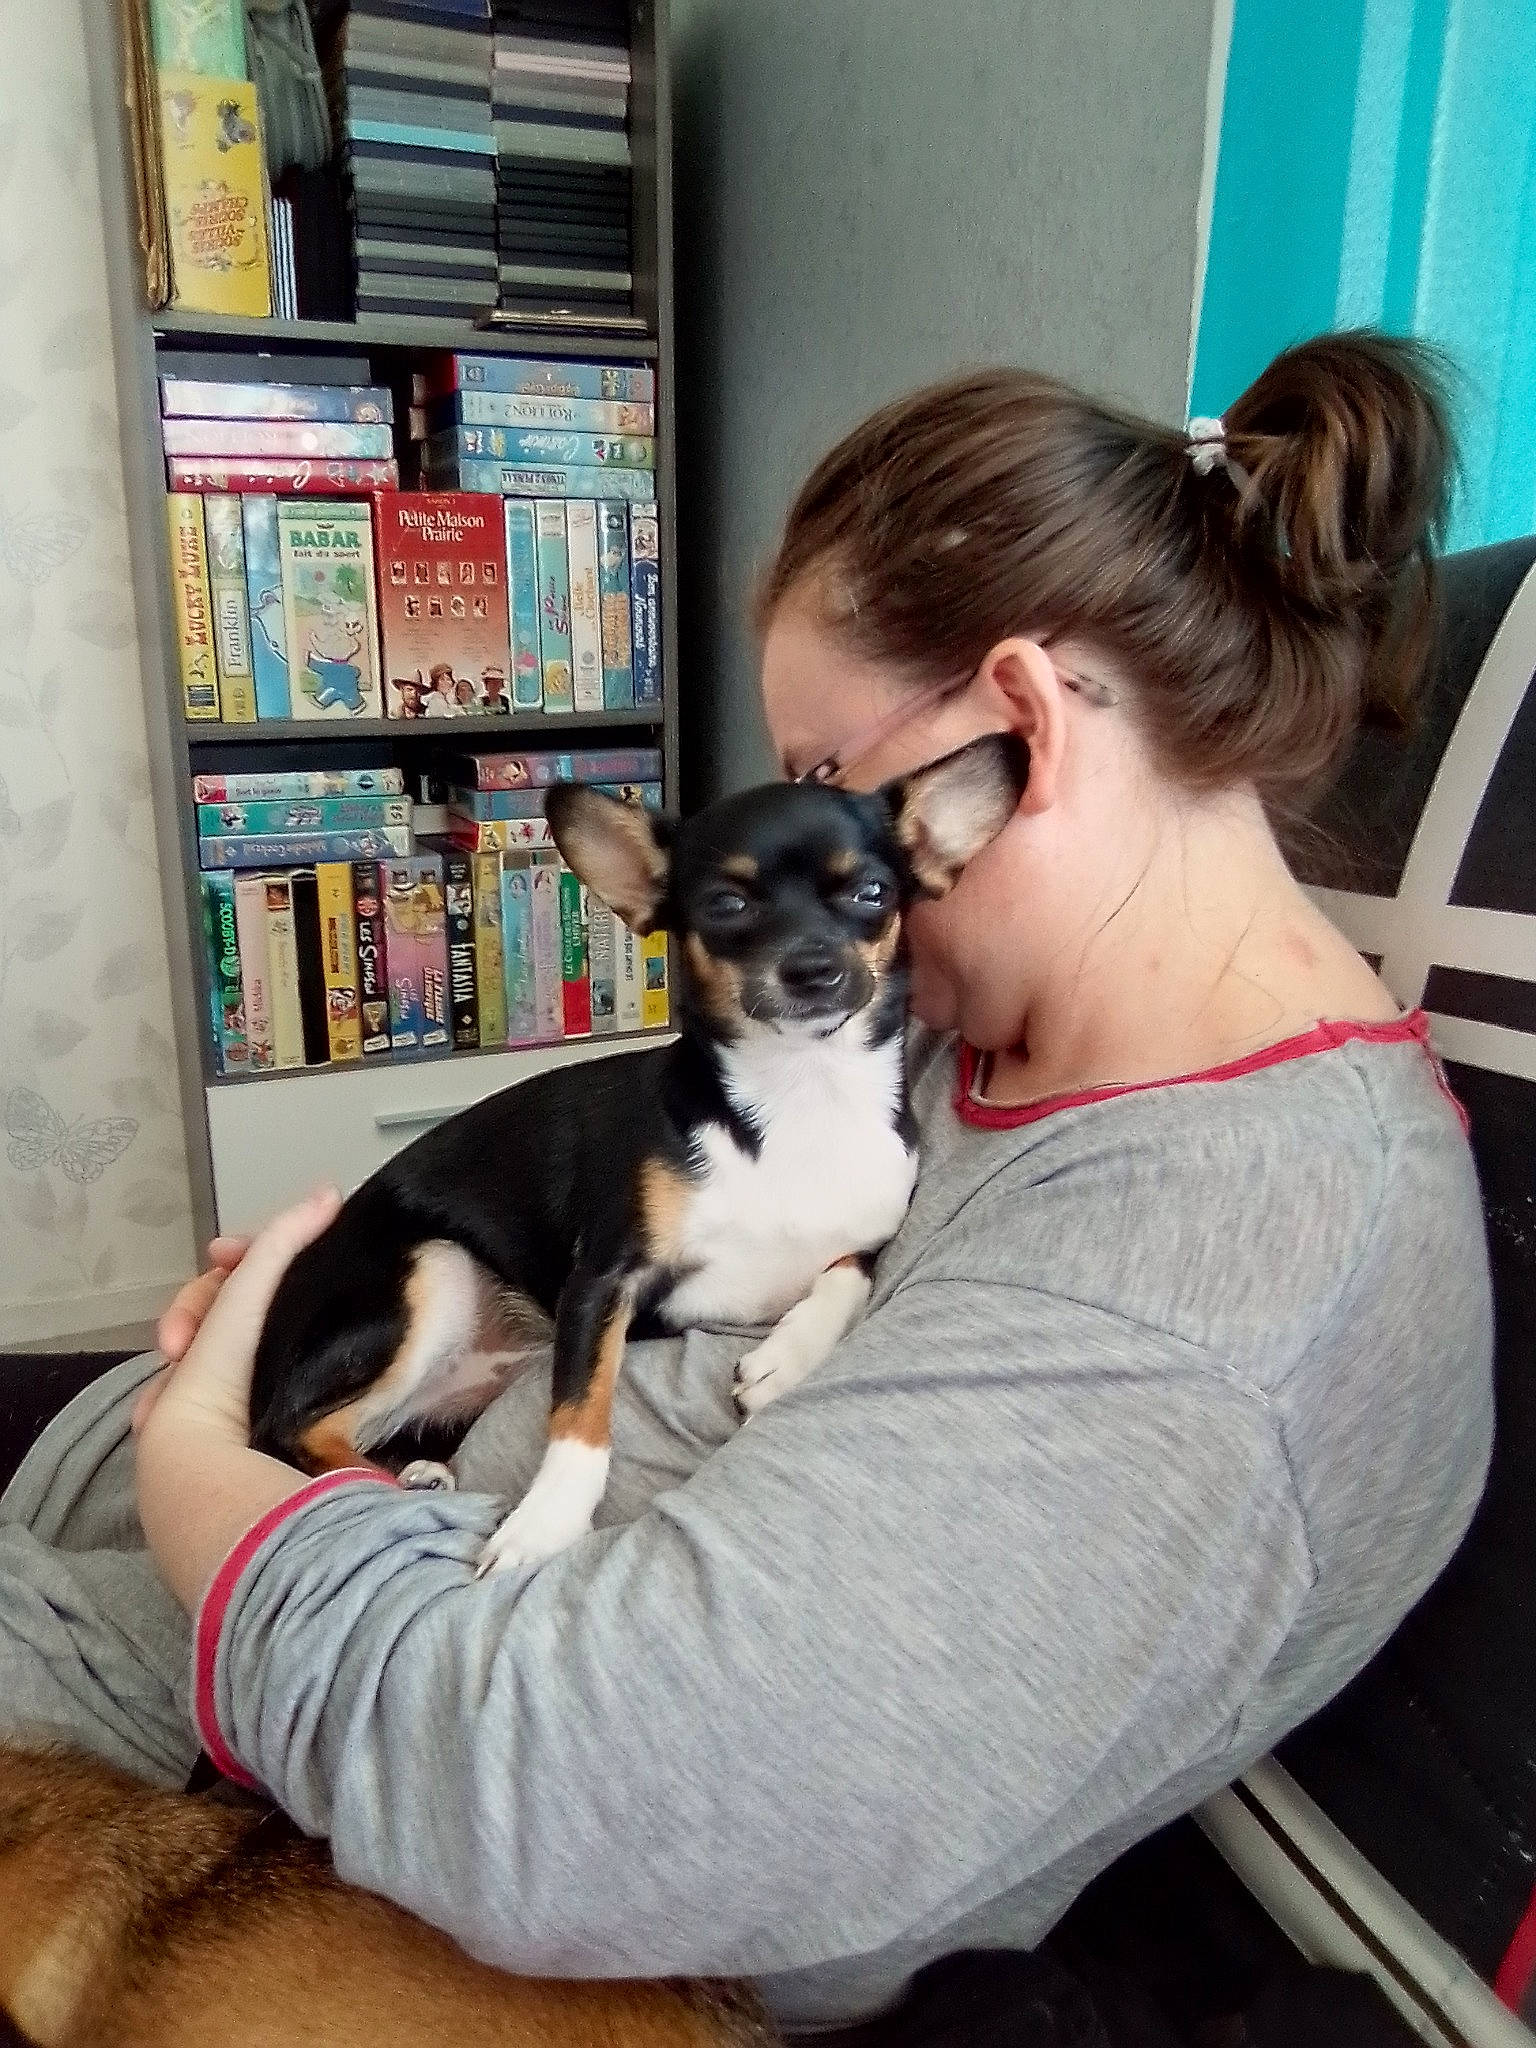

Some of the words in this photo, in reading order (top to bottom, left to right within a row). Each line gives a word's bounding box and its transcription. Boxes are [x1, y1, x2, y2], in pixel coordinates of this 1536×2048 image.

[289, 530, 361, 548] BABAR
[398, 510, 435, 527] Petite
[436, 510, 485, 528] Maison
[422, 526, 464, 542] Prairie
[177, 526, 202, 579] LUKE
[183, 584, 208, 647] LUCKY
[222, 599, 243, 668] Franklin
[358, 921, 373, 942] LES
[358, 944, 378, 995] SIMPSON
[449, 943, 476, 1004] FANTASIA
